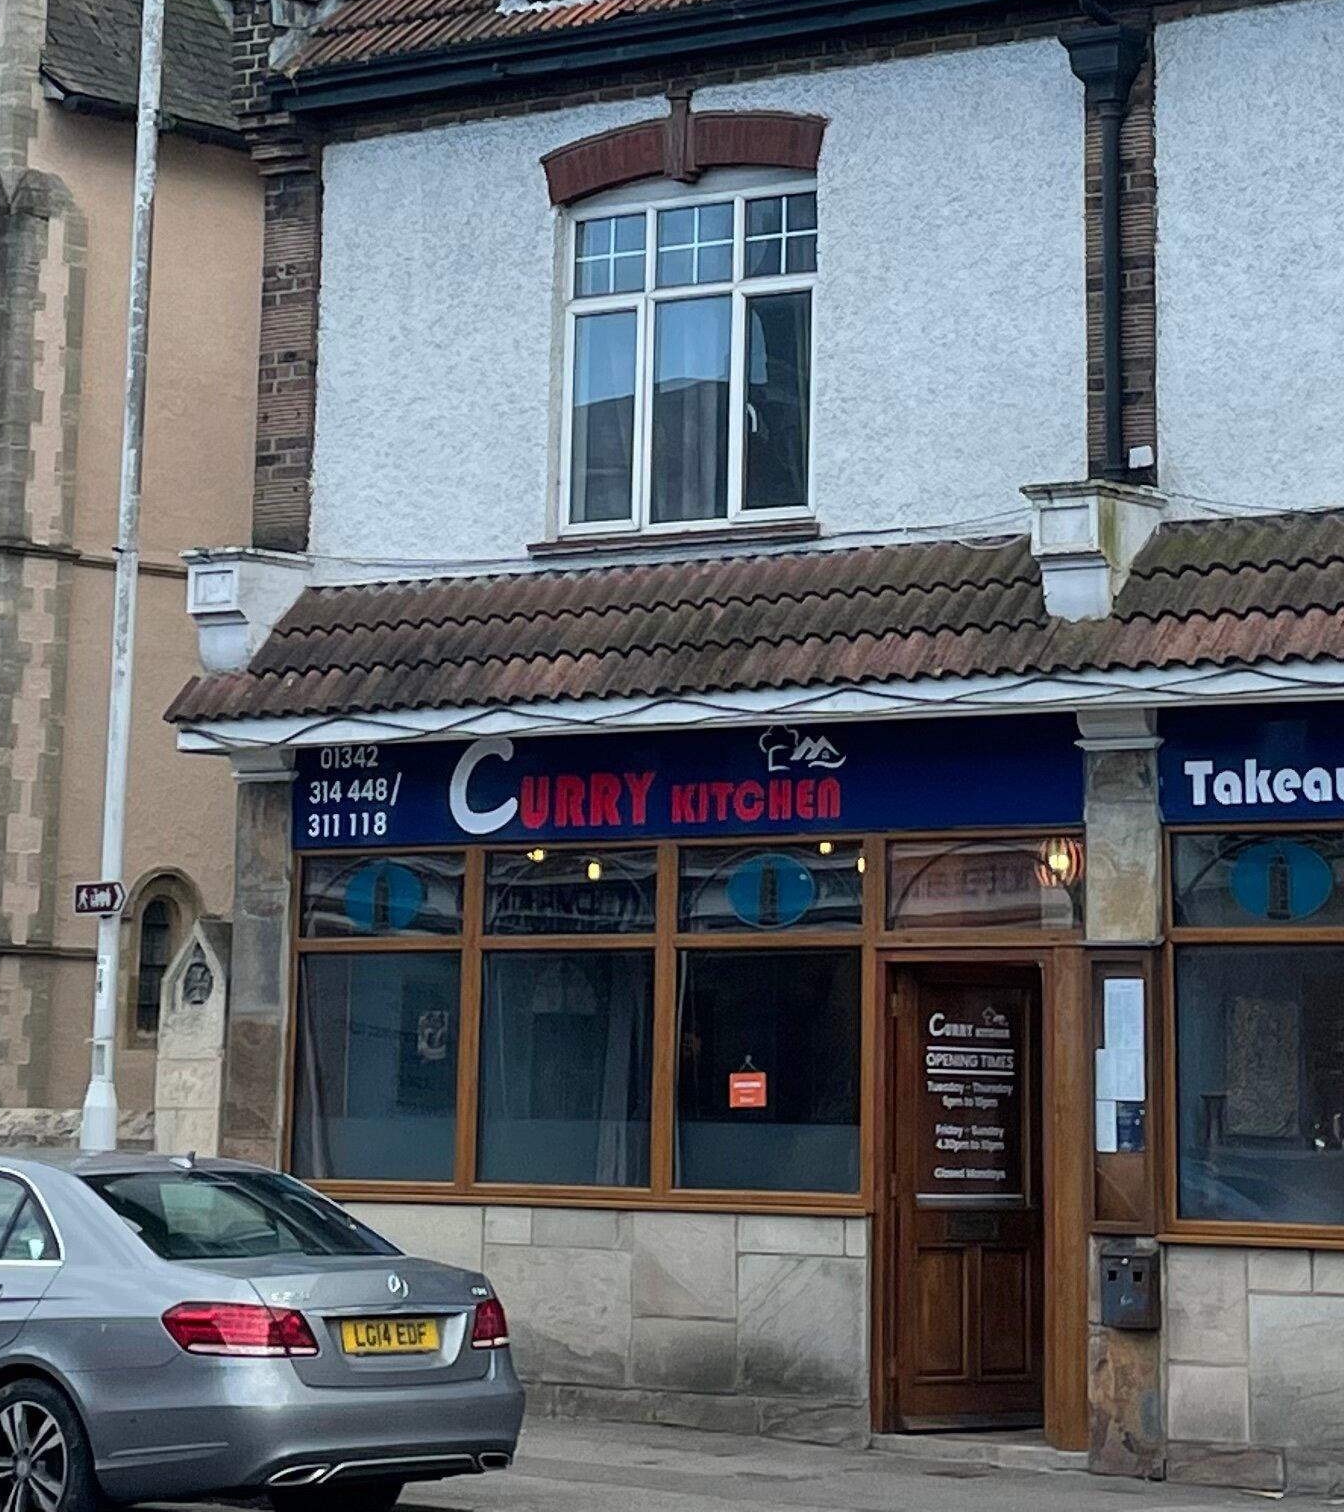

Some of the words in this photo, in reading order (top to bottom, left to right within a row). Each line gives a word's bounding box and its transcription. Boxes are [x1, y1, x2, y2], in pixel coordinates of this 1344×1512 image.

[320, 745, 379, 769] 01342
[309, 781, 342, 804] 314
[671, 776, 841, 824] KITCHEN
[308, 813, 340, 837] 311
[350, 812, 387, 836] 118
[926, 1053, 978, 1068] OPENING
[980, 1055, 1014, 1069] TIMES
